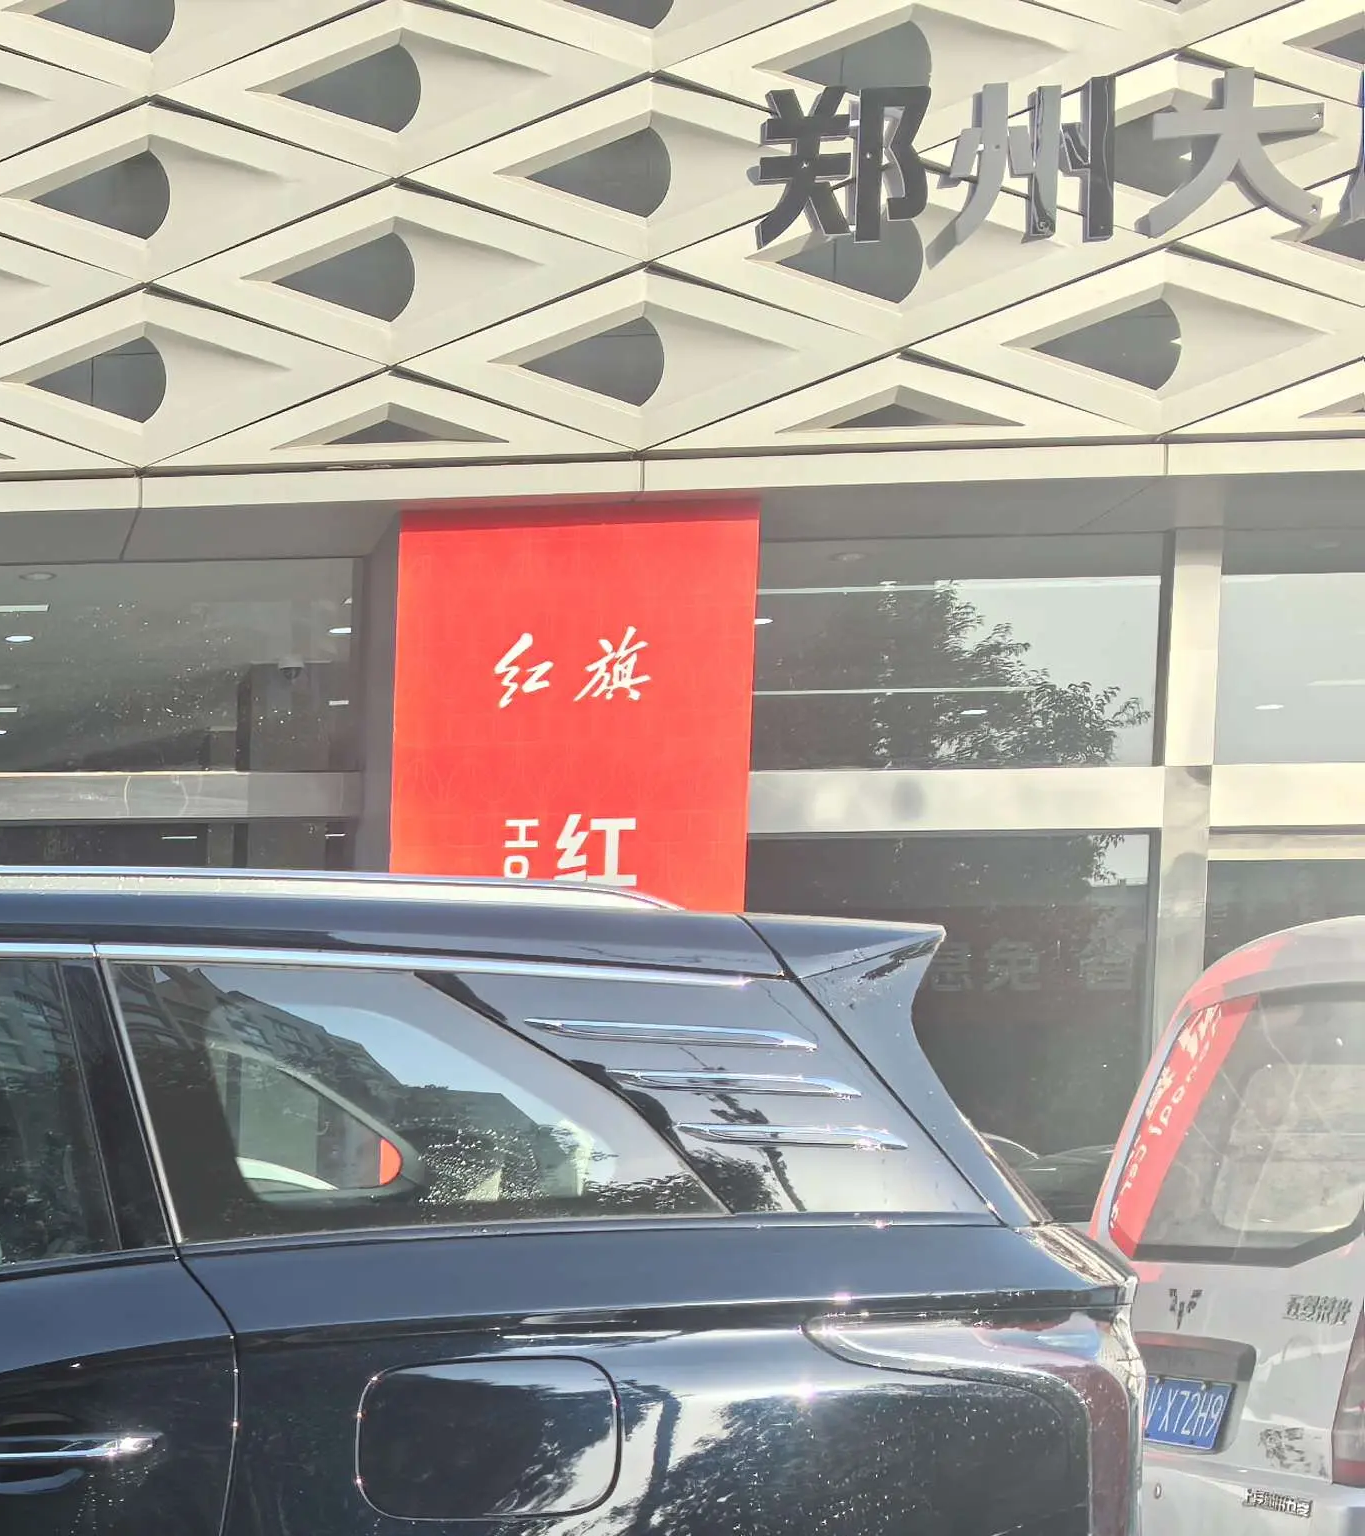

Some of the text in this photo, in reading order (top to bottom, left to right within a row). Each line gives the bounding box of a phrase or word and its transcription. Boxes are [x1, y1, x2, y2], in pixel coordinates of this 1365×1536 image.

[754, 66, 1365, 270] 郑州大
[493, 625, 652, 709] 红旗
[554, 813, 638, 887] 红
